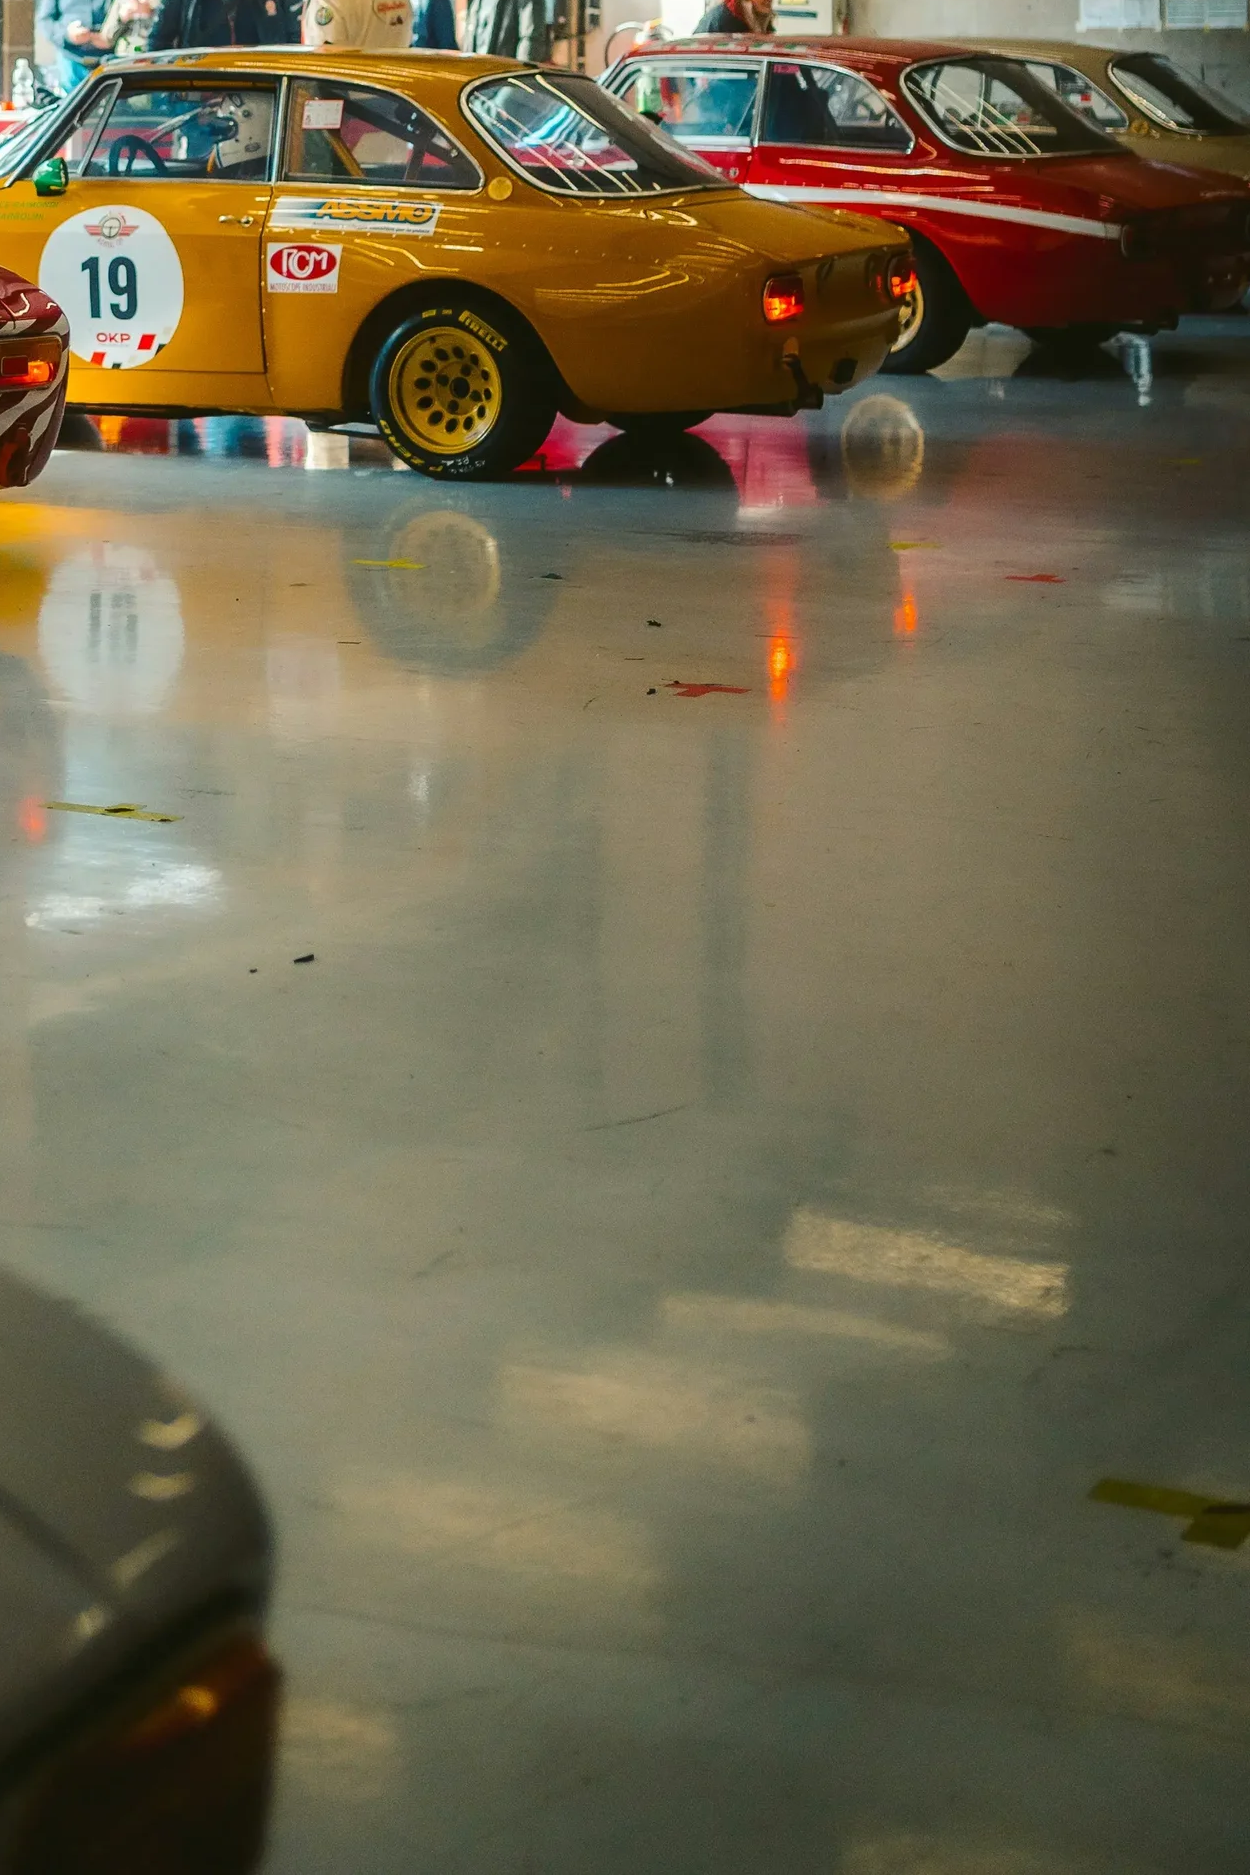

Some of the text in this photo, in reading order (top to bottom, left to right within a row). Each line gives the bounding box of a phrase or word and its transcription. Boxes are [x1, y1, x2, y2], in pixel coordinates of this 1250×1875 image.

[282, 248, 329, 278] RCM
[81, 256, 138, 320] 19
[96, 332, 131, 343] OKP
[458, 310, 508, 352] PIRELLI
